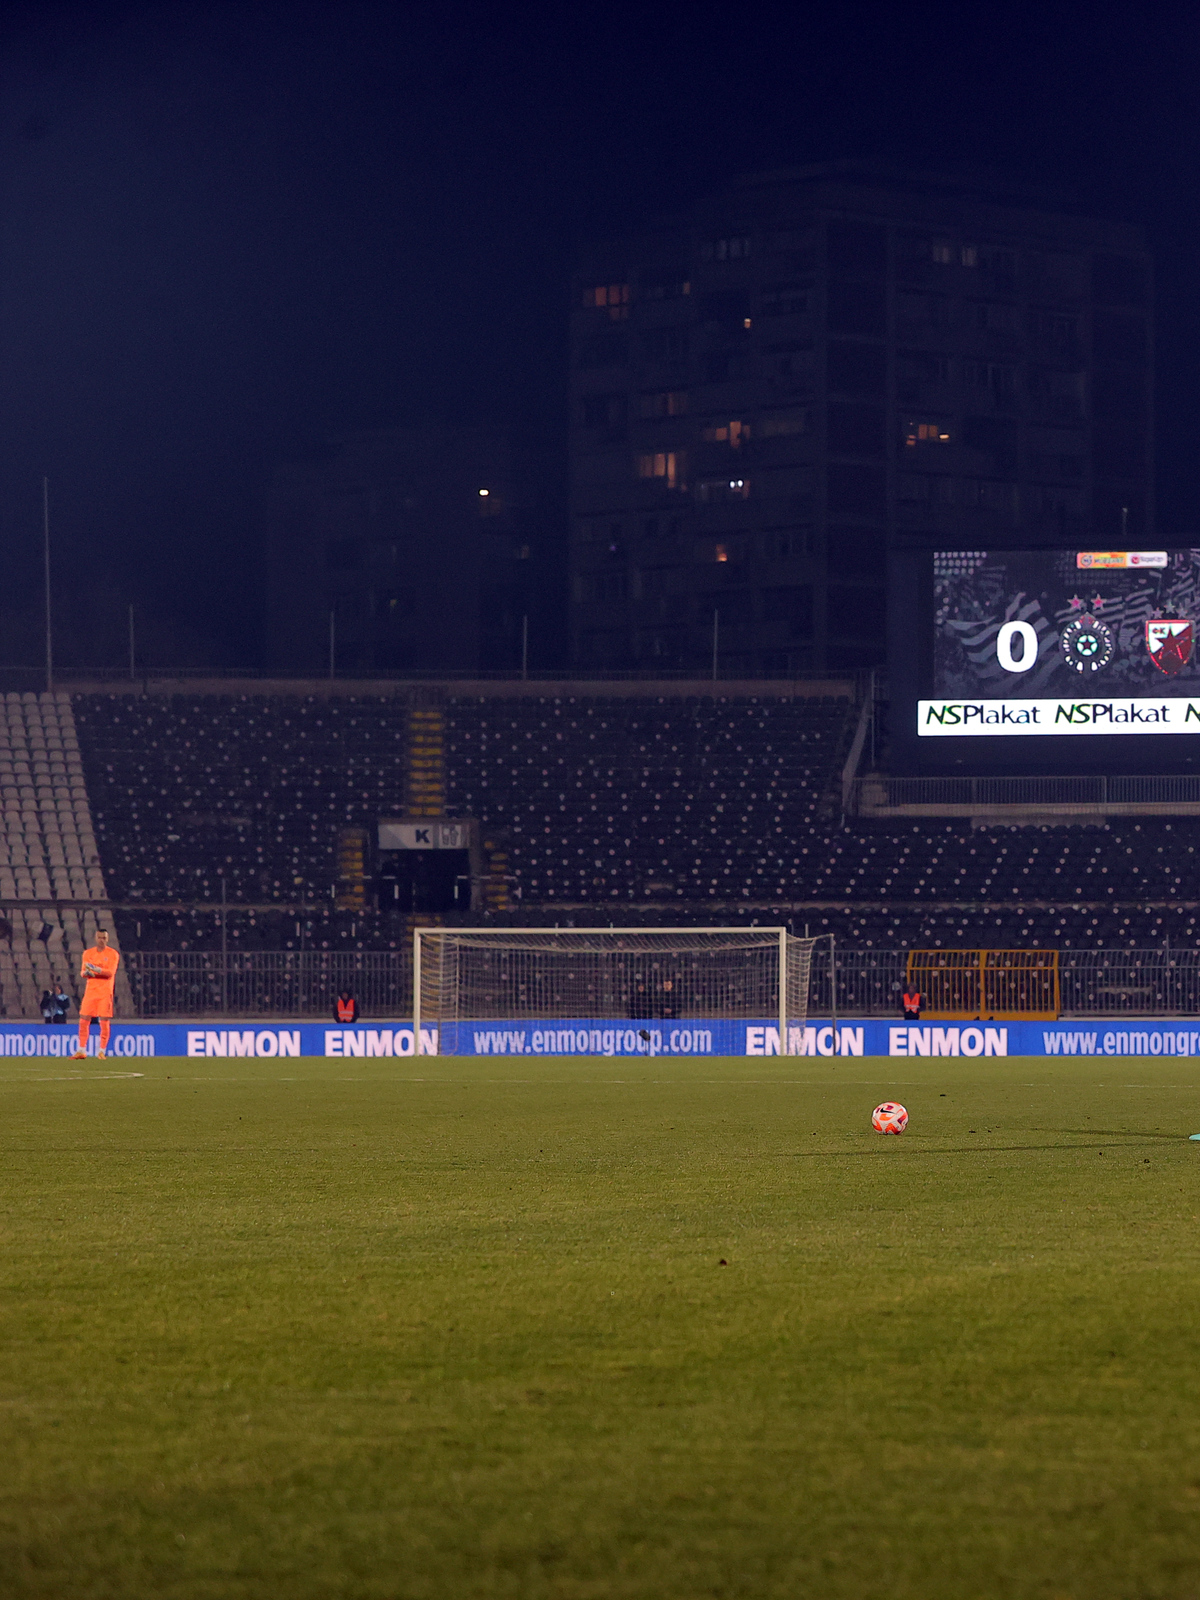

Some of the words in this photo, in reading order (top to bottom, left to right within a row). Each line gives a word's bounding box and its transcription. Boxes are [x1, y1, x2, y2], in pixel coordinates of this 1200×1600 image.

[996, 620, 1038, 673] 0
[926, 704, 1041, 725] NSPlakat
[1054, 703, 1171, 724] NSPlakat
[415, 829, 430, 844] K
[187, 1030, 301, 1057] ENMON
[325, 1029, 439, 1057] ENMON
[474, 1029, 712, 1057] www.enmongroup.com
[746, 1027, 864, 1057] ENMON
[889, 1028, 1008, 1057] ENMON
